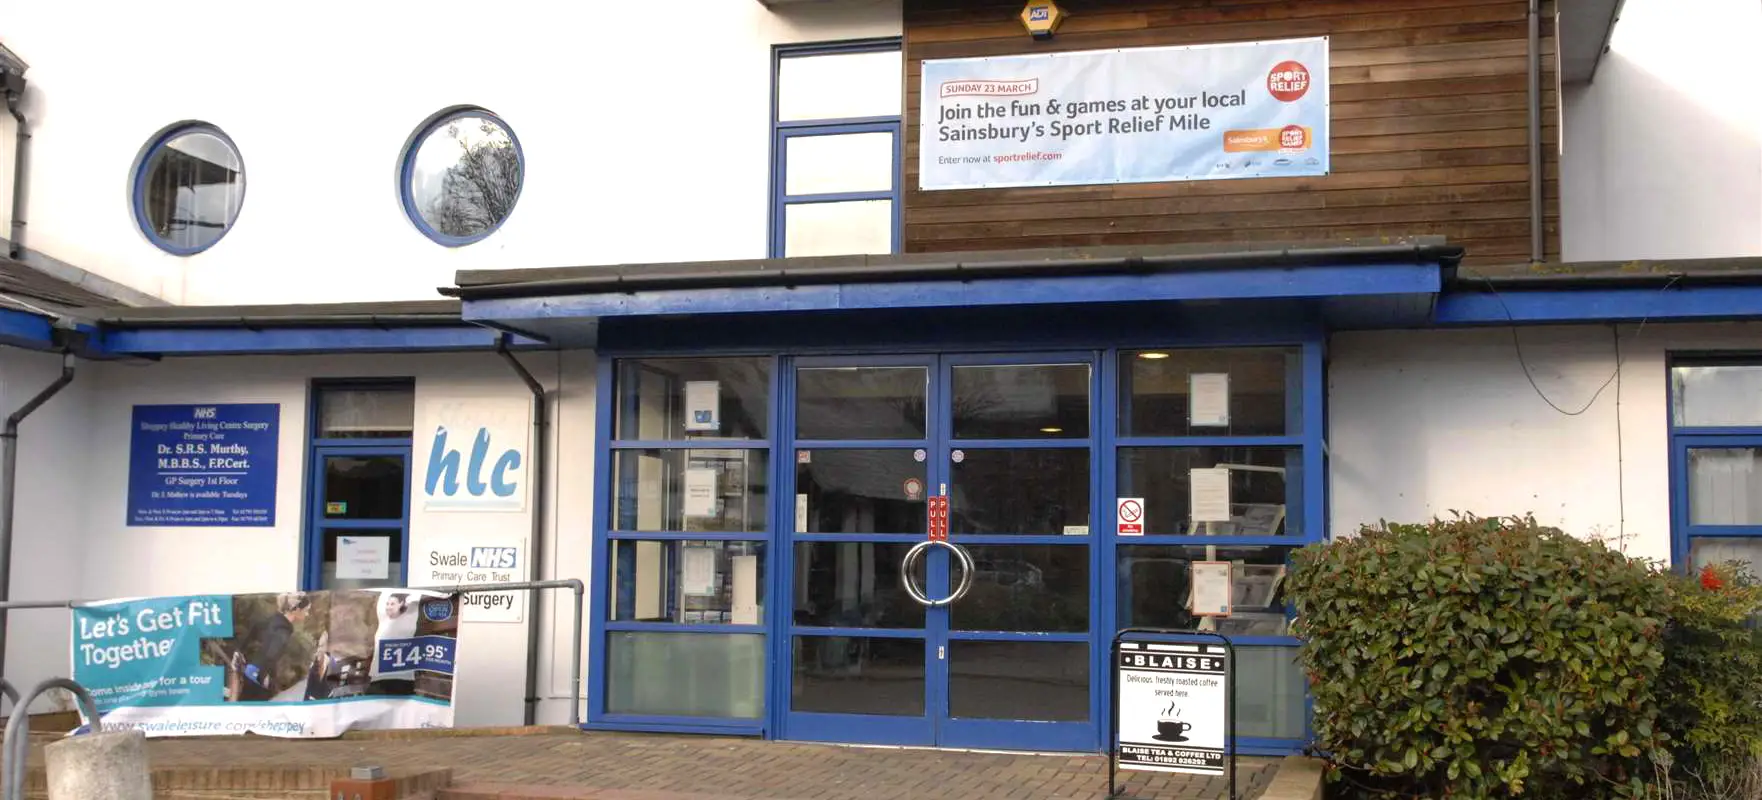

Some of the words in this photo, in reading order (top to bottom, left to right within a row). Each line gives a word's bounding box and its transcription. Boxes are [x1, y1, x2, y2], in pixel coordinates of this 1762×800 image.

[1031, 9, 1048, 19] ADT
[1270, 71, 1307, 83] SPORT
[946, 84, 982, 93] SUNDAY
[984, 84, 995, 93] 23
[998, 83, 1031, 92] MARCH
[1270, 81, 1307, 92] RELIEF
[938, 104, 971, 124] Join
[977, 102, 1006, 119] the
[1011, 100, 1040, 117] fun
[1046, 99, 1061, 115] &
[1066, 99, 1126, 118] games
[1131, 95, 1150, 111] at
[1154, 95, 1197, 114] your
[1202, 89, 1245, 108] local
[939, 121, 1045, 142] Sainsbury's
[1050, 119, 1101, 140] Sport
[1108, 114, 1164, 134] Relief
[1169, 113, 1210, 131] Mile
[938, 155, 961, 165] Enter
[963, 156, 980, 164] now
[983, 154, 991, 163] at
[993, 151, 1063, 166] sportrelief.com
[194, 407, 216, 419] NHS
[197, 421, 218, 431] Living
[220, 421, 241, 430] Centre
[243, 421, 269, 431] Surgery
[184, 433, 208, 441] Primary
[209, 432, 225, 440] Care
[158, 444, 172, 454] Dr.
[176, 444, 207, 454] S.R.S.
[210, 444, 249, 456] Murthy,
[158, 458, 206, 470] M.B.B.S.,
[424, 425, 521, 497] hlc
[165, 477, 178, 485] GP
[179, 477, 205, 488] Surgery
[207, 476, 218, 485] 1st
[219, 476, 239, 485] Floor
[430, 551, 468, 567] Swale
[471, 547, 516, 568] NHS
[432, 570, 463, 583] Primary
[467, 571, 487, 582] Care
[492, 571, 510, 582] Trust
[463, 591, 514, 610] Surgery
[81, 613, 130, 639] Let's
[136, 607, 183, 632] Get
[188, 602, 222, 626] Fit
[1134, 655, 1212, 670] BLAISE
[88, 687, 113, 697] ome
[159, 676, 177, 685] for
[179, 677, 187, 685] a
[189, 676, 212, 684] tour
[1155, 675, 1175, 687] freshly
[1176, 677, 1198, 687] roasted
[1199, 678, 1218, 687] coffee
[1155, 689, 1174, 698] served
[1122, 746, 1149, 755] BLAISE
[1151, 748, 1166, 756] TEA
[1174, 750, 1204, 759] COFFEE
[1206, 752, 1221, 760] LTD
[1137, 754, 1154, 762] TEL:
